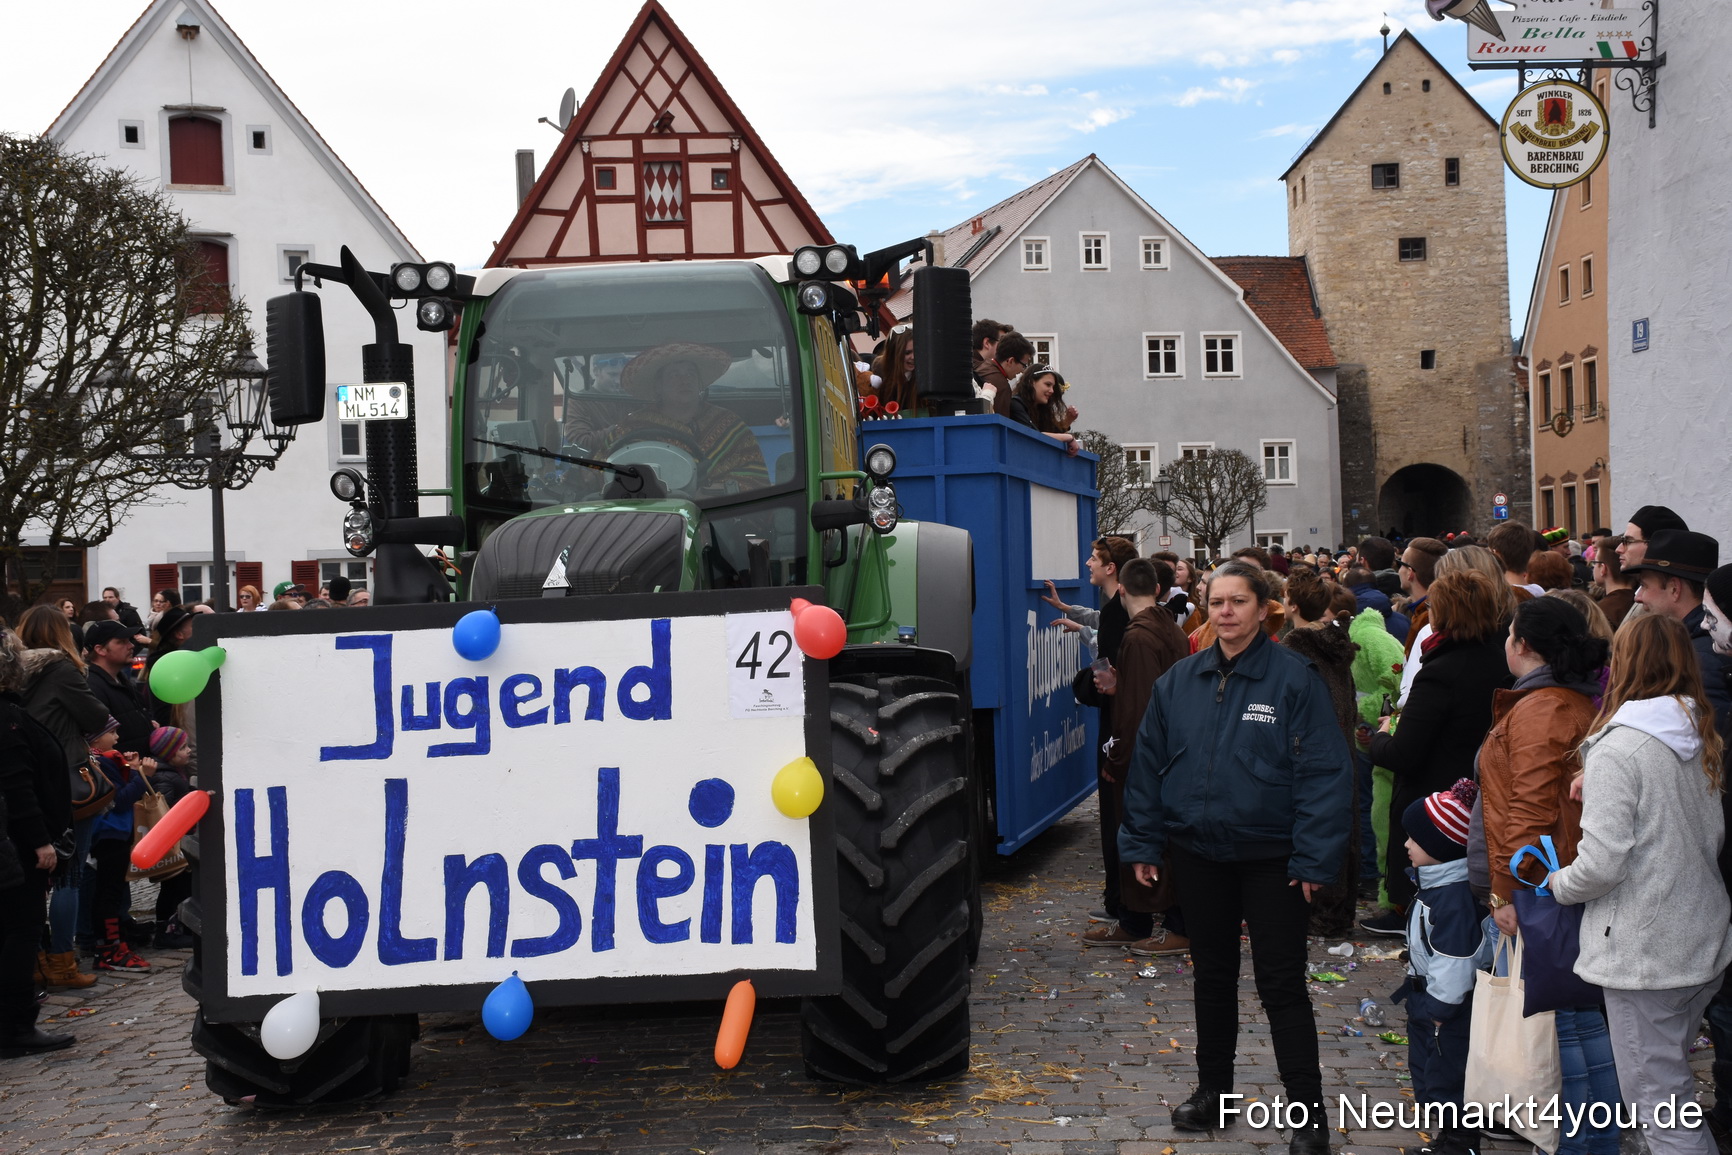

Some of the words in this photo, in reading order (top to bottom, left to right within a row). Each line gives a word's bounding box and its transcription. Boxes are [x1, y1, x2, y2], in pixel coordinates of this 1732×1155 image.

[1511, 15, 1549, 23] Pizzeria
[1559, 14, 1581, 23] Cafe
[1590, 14, 1628, 22] Eisdiele
[1521, 27, 1586, 39] Bella
[1476, 42, 1546, 54] Roma
[1537, 90, 1573, 100] WINKLER
[1516, 109, 1532, 117] SEIT
[1559, 126, 1589, 147] BERCHING
[1527, 151, 1584, 161] BÄRENBRÄU
[1530, 163, 1579, 173] BERCHING
[355, 387, 375, 401] NM
[735, 630, 793, 680] 42
[319, 618, 673, 762] Jugend
[1247, 703, 1275, 714] CONSEC
[1242, 713, 1277, 724] SECURITY
